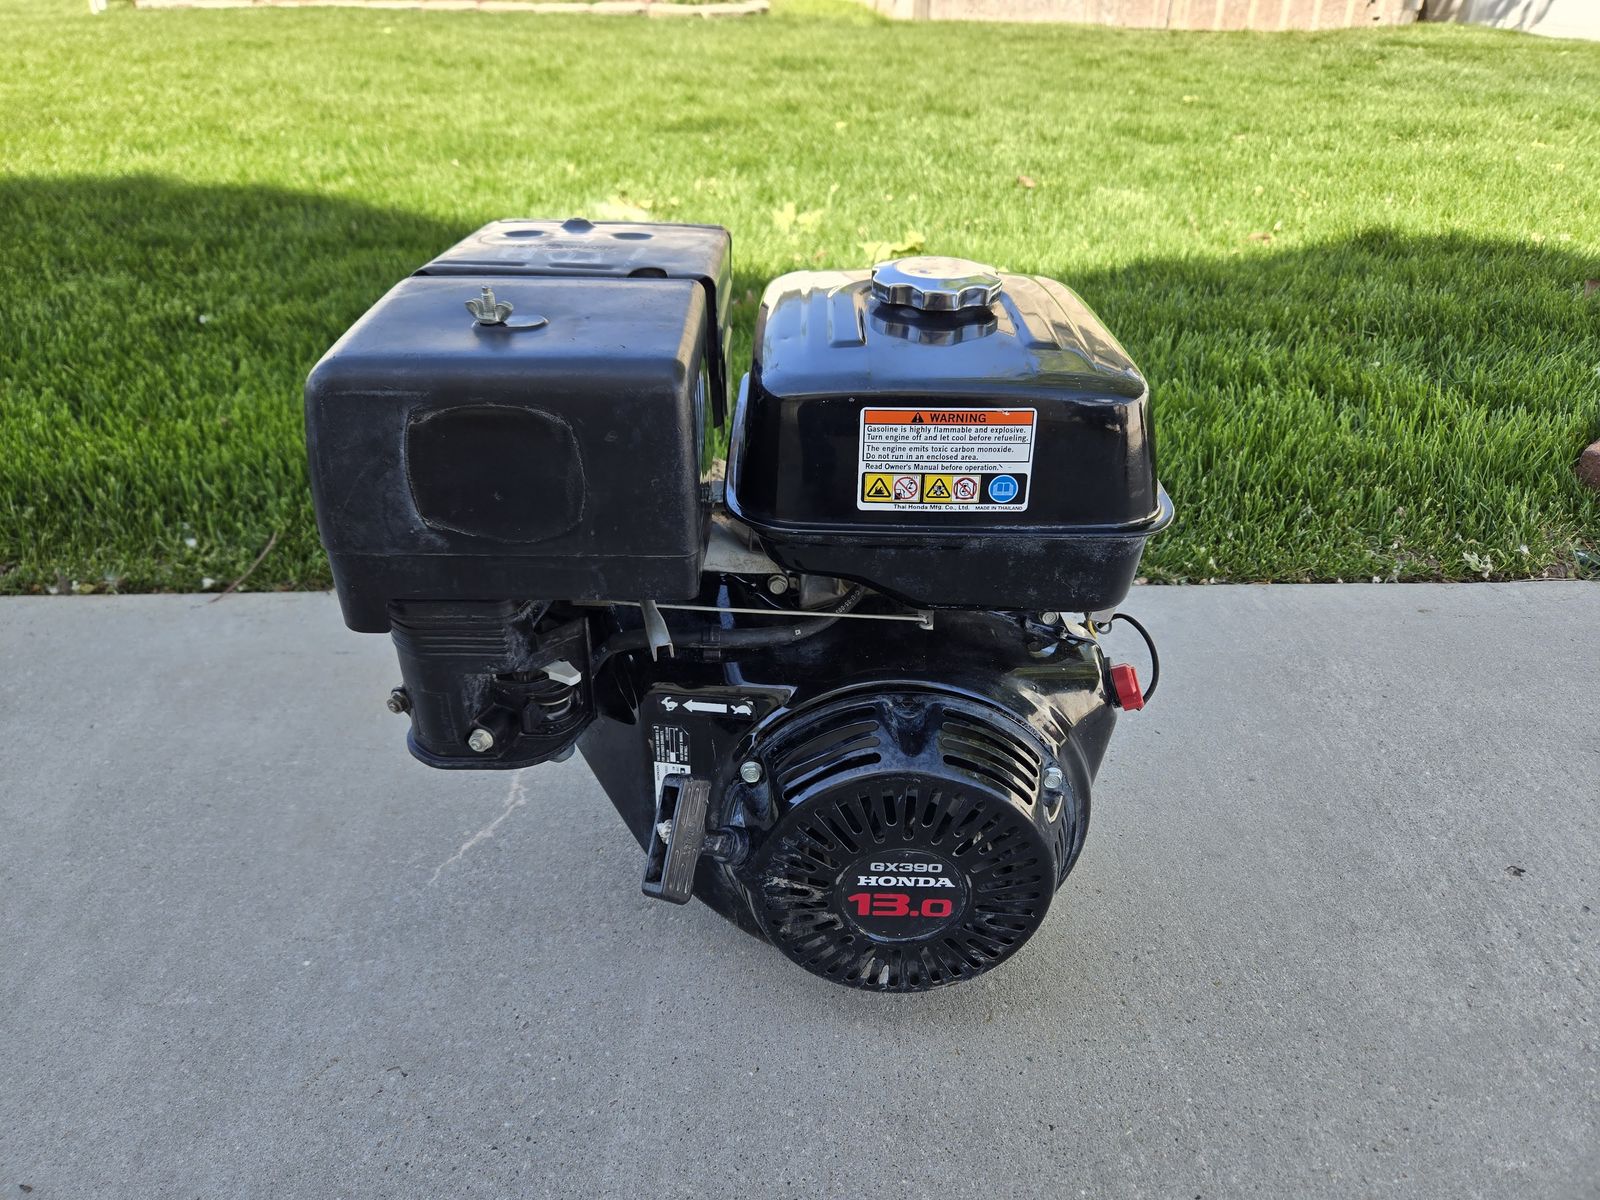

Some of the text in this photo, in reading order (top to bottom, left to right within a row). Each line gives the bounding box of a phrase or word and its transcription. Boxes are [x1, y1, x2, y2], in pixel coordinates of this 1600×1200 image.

[930, 413, 986, 423] WARNING
[867, 425, 899, 433] Gasoline
[900, 425, 907, 433] is
[909, 425, 931, 435] highly
[933, 425, 972, 433] flammable
[990, 426, 1026, 435] explosive.
[867, 433, 883, 441] Turn
[885, 433, 909, 443] engine
[911, 433, 922, 441] off
[994, 435, 1029, 443] refueling.
[882, 445, 907, 453] engine
[964, 464, 999, 472] operation.
[870, 862, 943, 873] GX390
[857, 875, 956, 888] HONDA
[847, 893, 953, 917] 13.0
